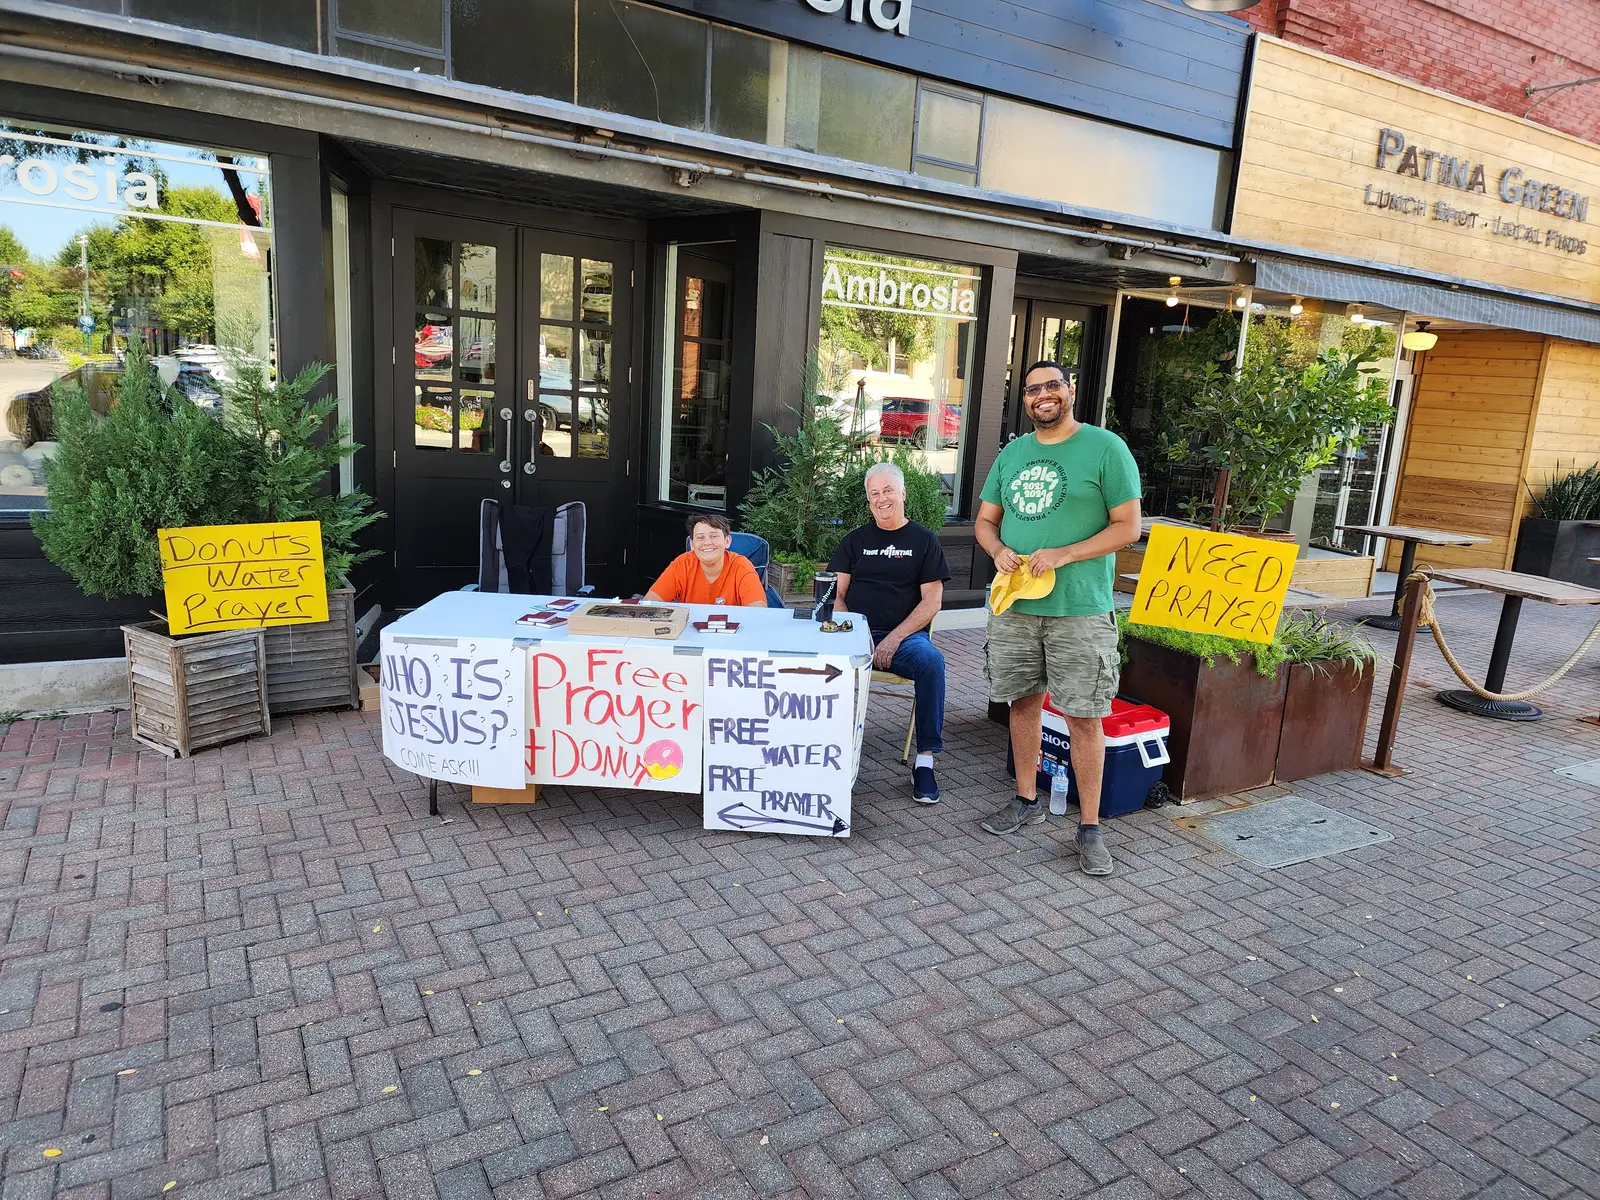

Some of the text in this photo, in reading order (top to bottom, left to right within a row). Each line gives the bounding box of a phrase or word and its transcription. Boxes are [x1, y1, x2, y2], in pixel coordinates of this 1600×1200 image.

[1376, 127, 1590, 222] PATINA GREEN
[1364, 184, 1588, 255] LUNCH SPOT LOCAL FINDS
[822, 263, 975, 313] Ambrosia
[1026, 459, 1068, 511] PROSPER HIGH SCHOOL
[1012, 491, 1054, 515] staff
[165, 530, 312, 562] Donuts
[863, 548, 879, 556] TRUE
[880, 544, 912, 558] POTENTIAL
[208, 561, 311, 588] Water
[1167, 536, 1283, 592] NEED
[183, 593, 314, 626] Prayer
[1145, 579, 1277, 635] PRAYER
[450, 657, 503, 701] IS
[587, 649, 688, 692] Free
[708, 657, 776, 690] FREE
[532, 652, 702, 745] Prayer
[764, 690, 839, 721] DONUT
[388, 696, 509, 750] JESUS?
[708, 717, 769, 745] FREE
[761, 743, 842, 771] WATER
[1041, 731, 1070, 750] GLOO
[400, 747, 437, 773] COME
[708, 764, 767, 793] FREE
[760, 790, 833, 821] PRAYER
